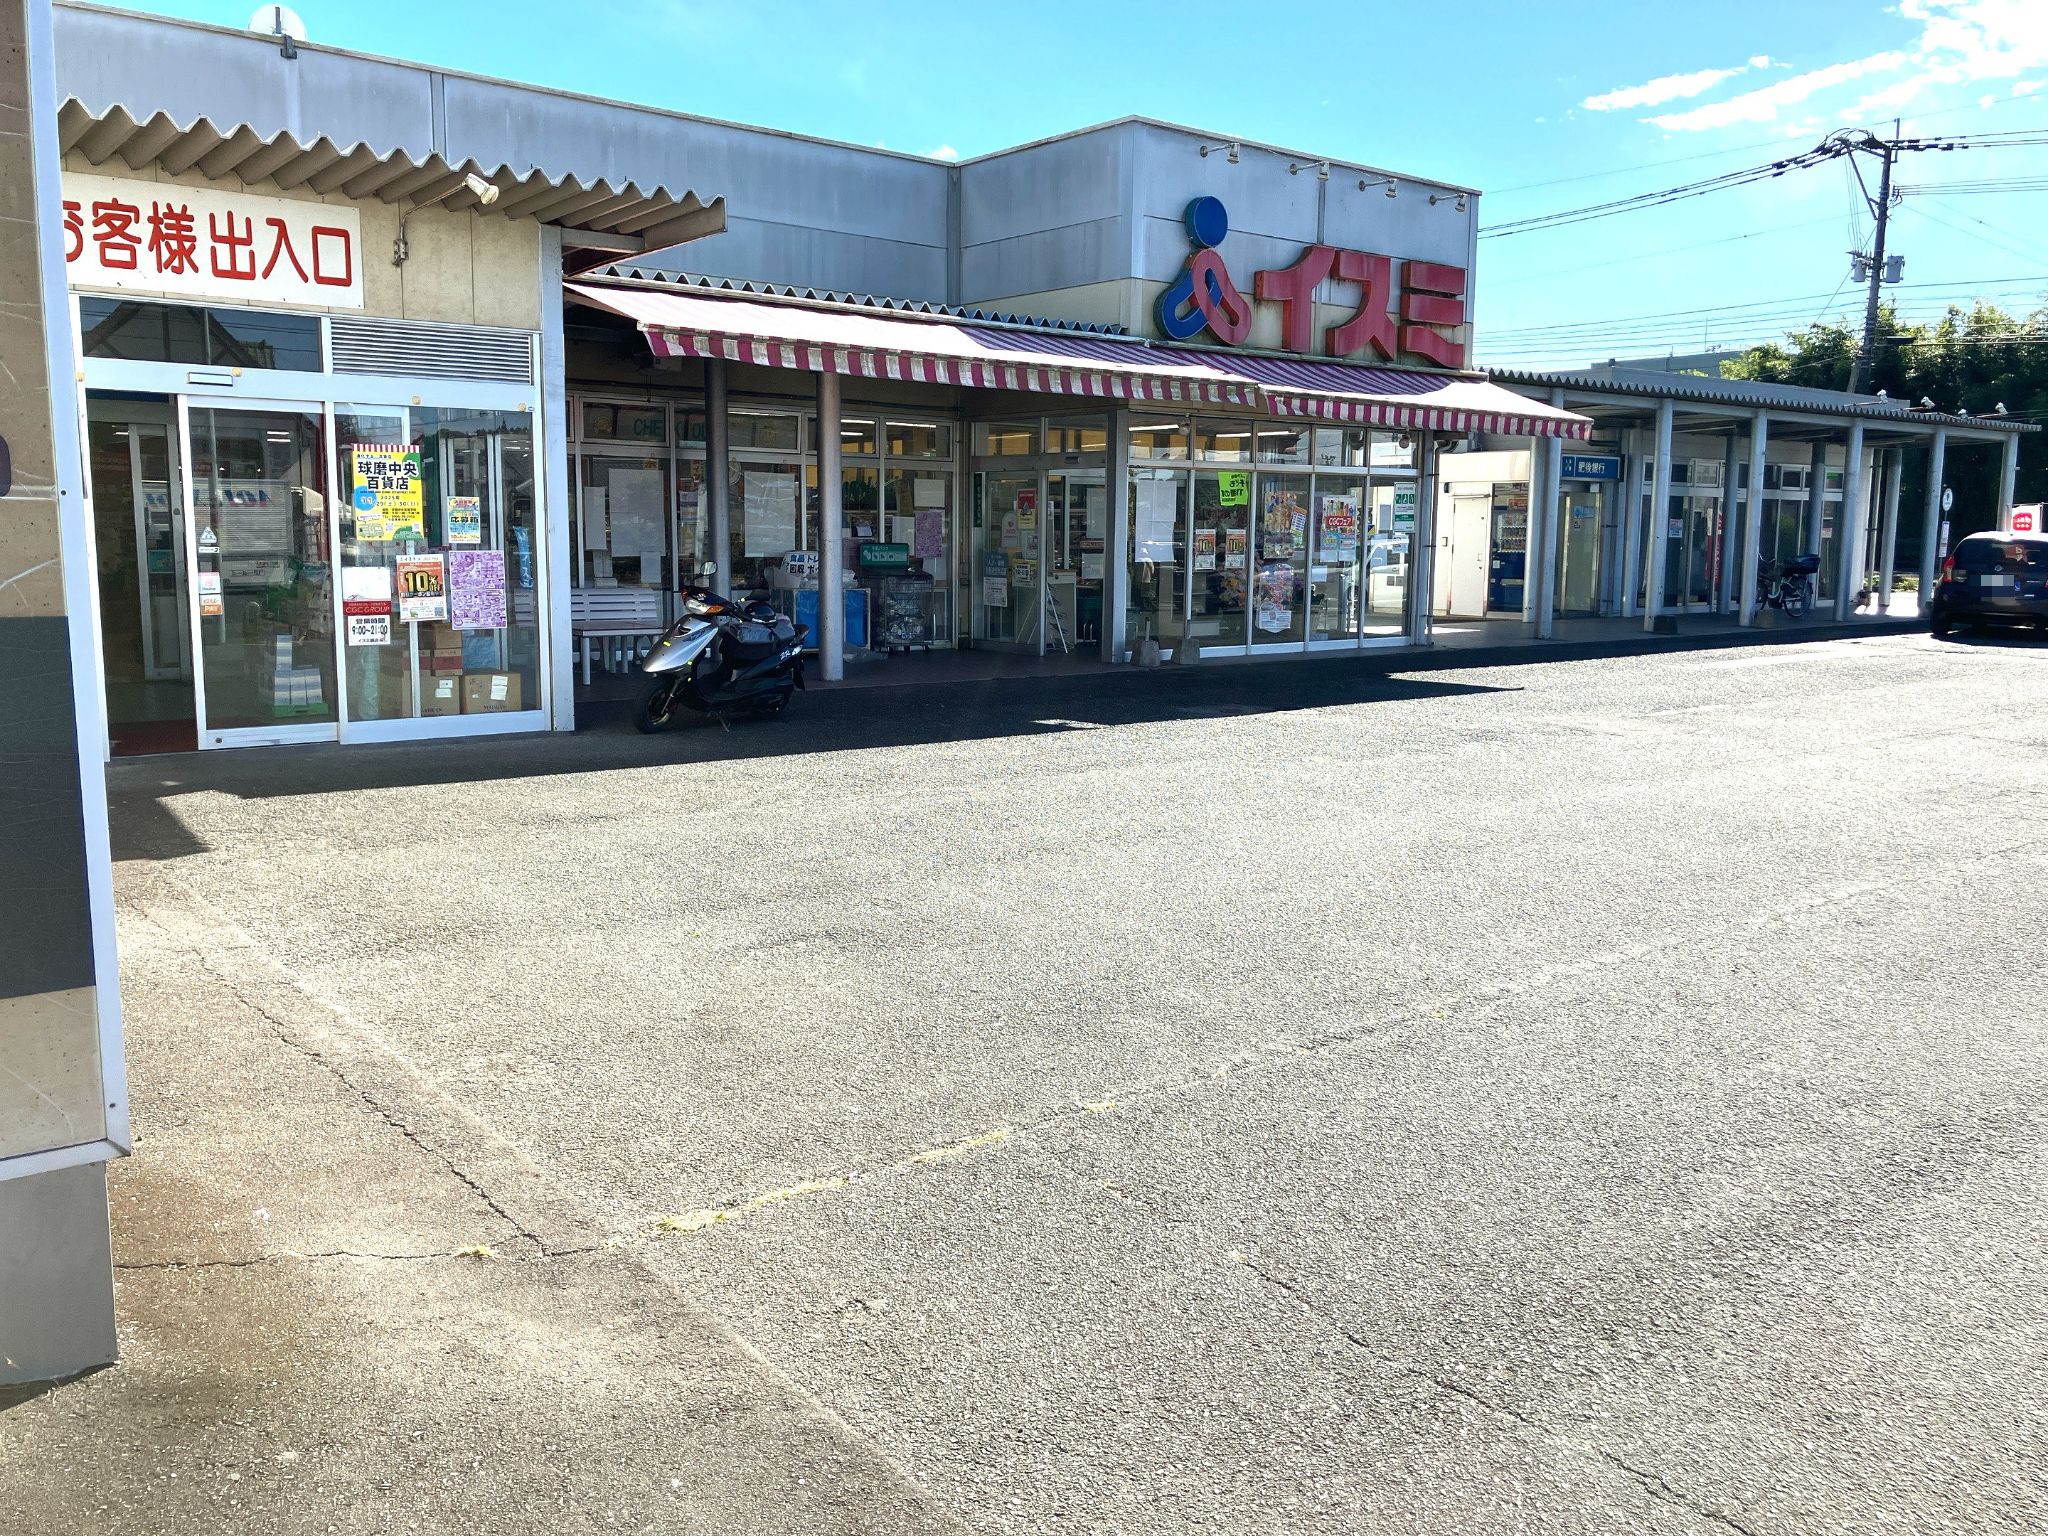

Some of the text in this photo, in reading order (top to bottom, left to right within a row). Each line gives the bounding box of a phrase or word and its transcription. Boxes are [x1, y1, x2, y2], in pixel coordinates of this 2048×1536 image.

[1254, 245, 1466, 368] イスミ
[358, 461, 417, 476] 球磨中央
[1578, 461, 1606, 474] 肥後銀行
[367, 476, 409, 490] 百貨店
[345, 605, 390, 614] CGC GROUP
